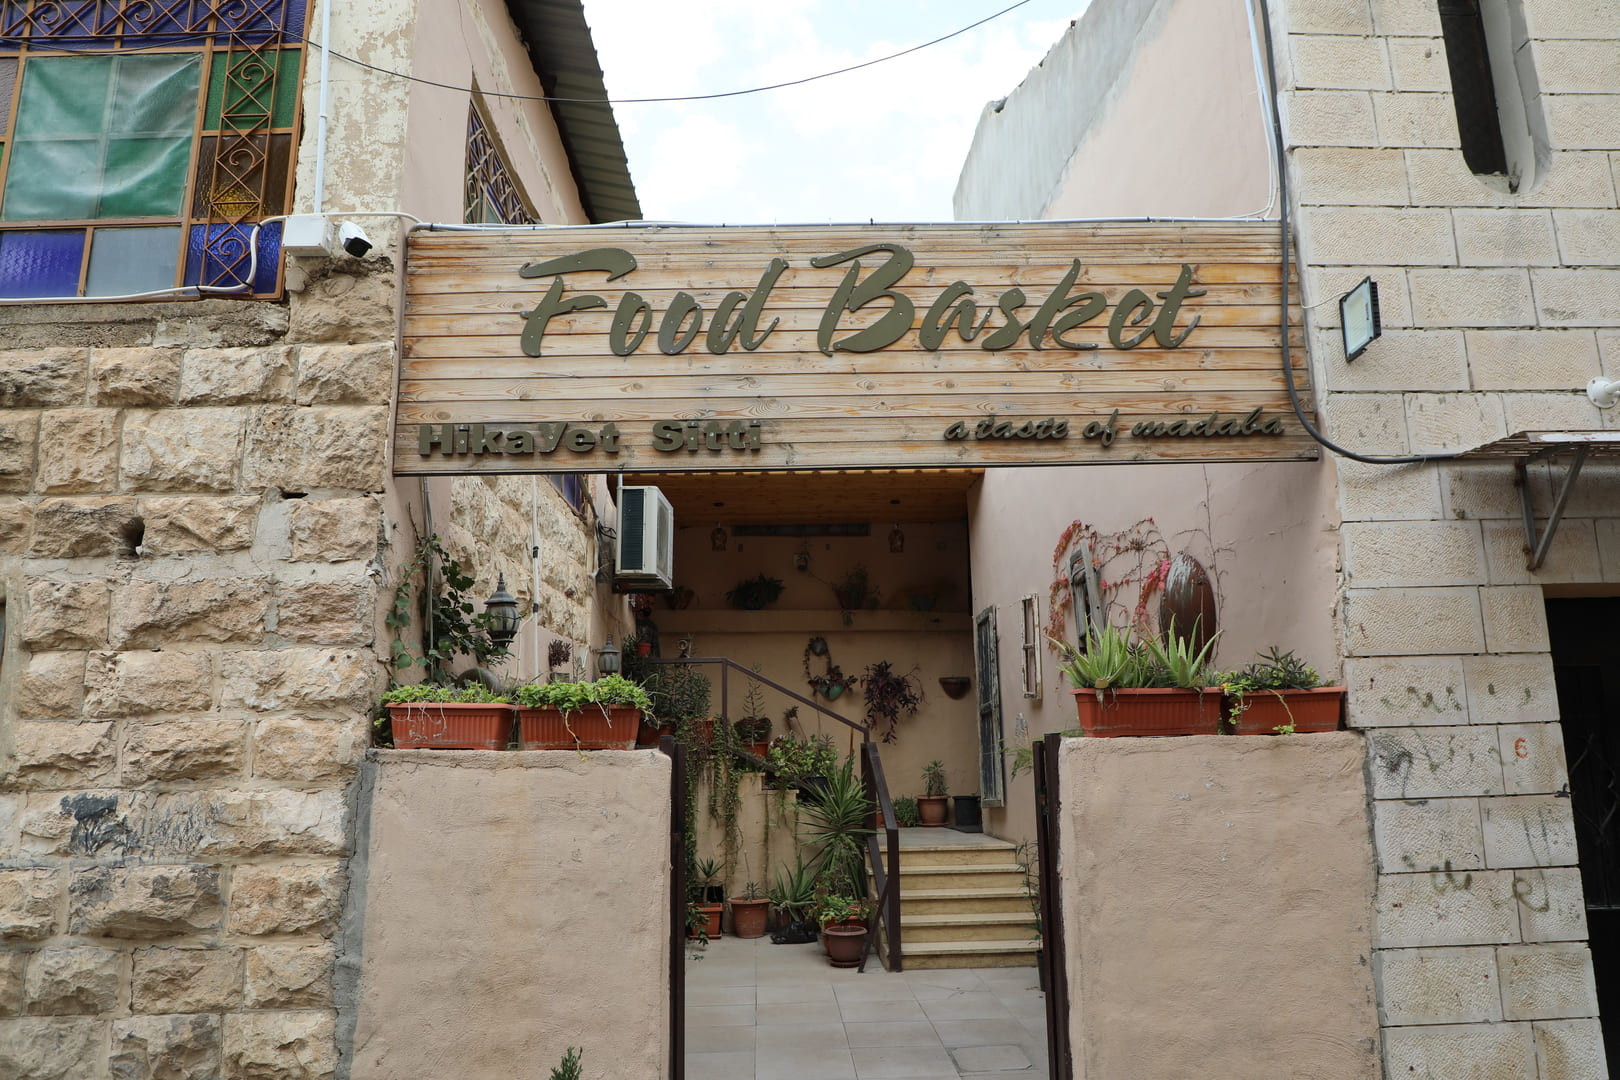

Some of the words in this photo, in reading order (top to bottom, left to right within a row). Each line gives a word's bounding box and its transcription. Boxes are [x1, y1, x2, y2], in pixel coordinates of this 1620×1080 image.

[518, 247, 790, 358] Food
[810, 243, 1207, 357] Basket
[651, 419, 762, 452] Sitti
[943, 418, 970, 441] a
[975, 414, 1070, 440] taste
[1082, 408, 1120, 448] of
[1131, 405, 1285, 438] madaba
